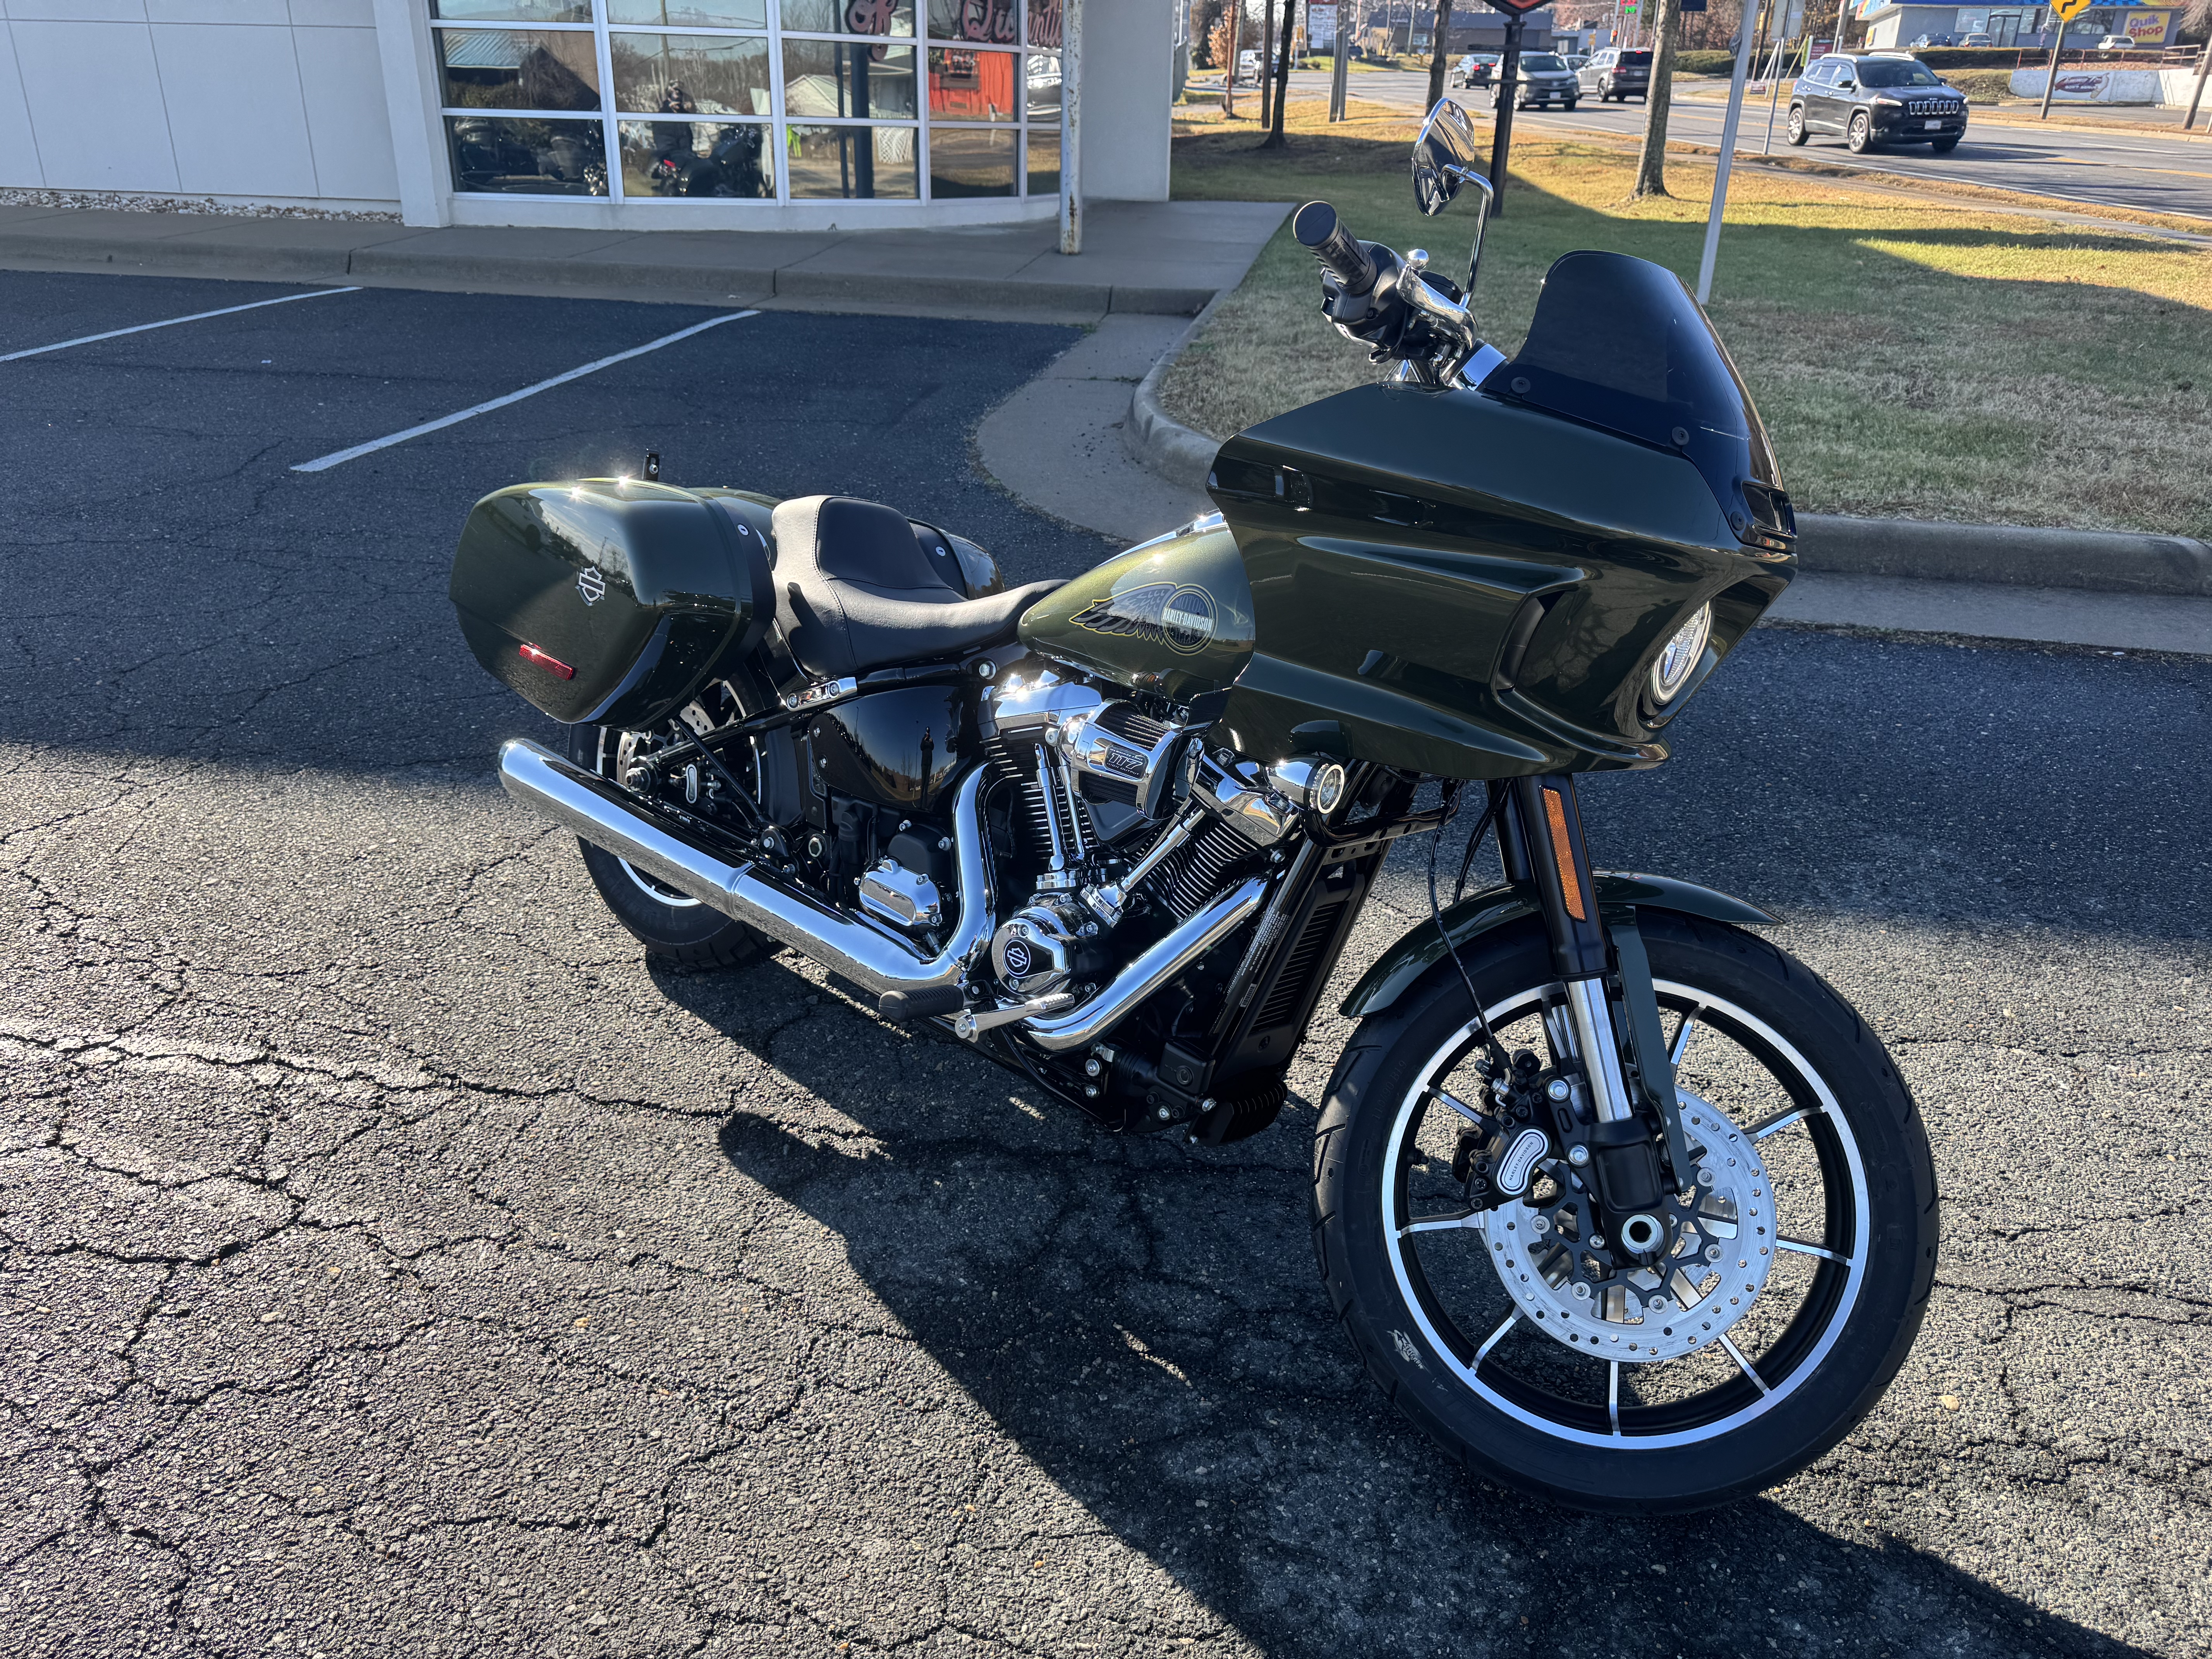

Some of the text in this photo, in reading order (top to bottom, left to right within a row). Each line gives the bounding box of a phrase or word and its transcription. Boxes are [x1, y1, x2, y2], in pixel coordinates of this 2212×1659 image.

[2130, 15, 2159, 27] Quik
[2129, 26, 2164, 38] Shop
[1175, 595, 1205, 614] MOTOR
[1163, 607, 1213, 632] HARLEY-DAVIDSON
[1109, 753, 1143, 769] 117
[1120, 767, 1140, 775] OUTPUT
[1372, 1081, 1394, 1121] 110/90
[1509, 1141, 1534, 1181] HARLEY-DAVIDSON
